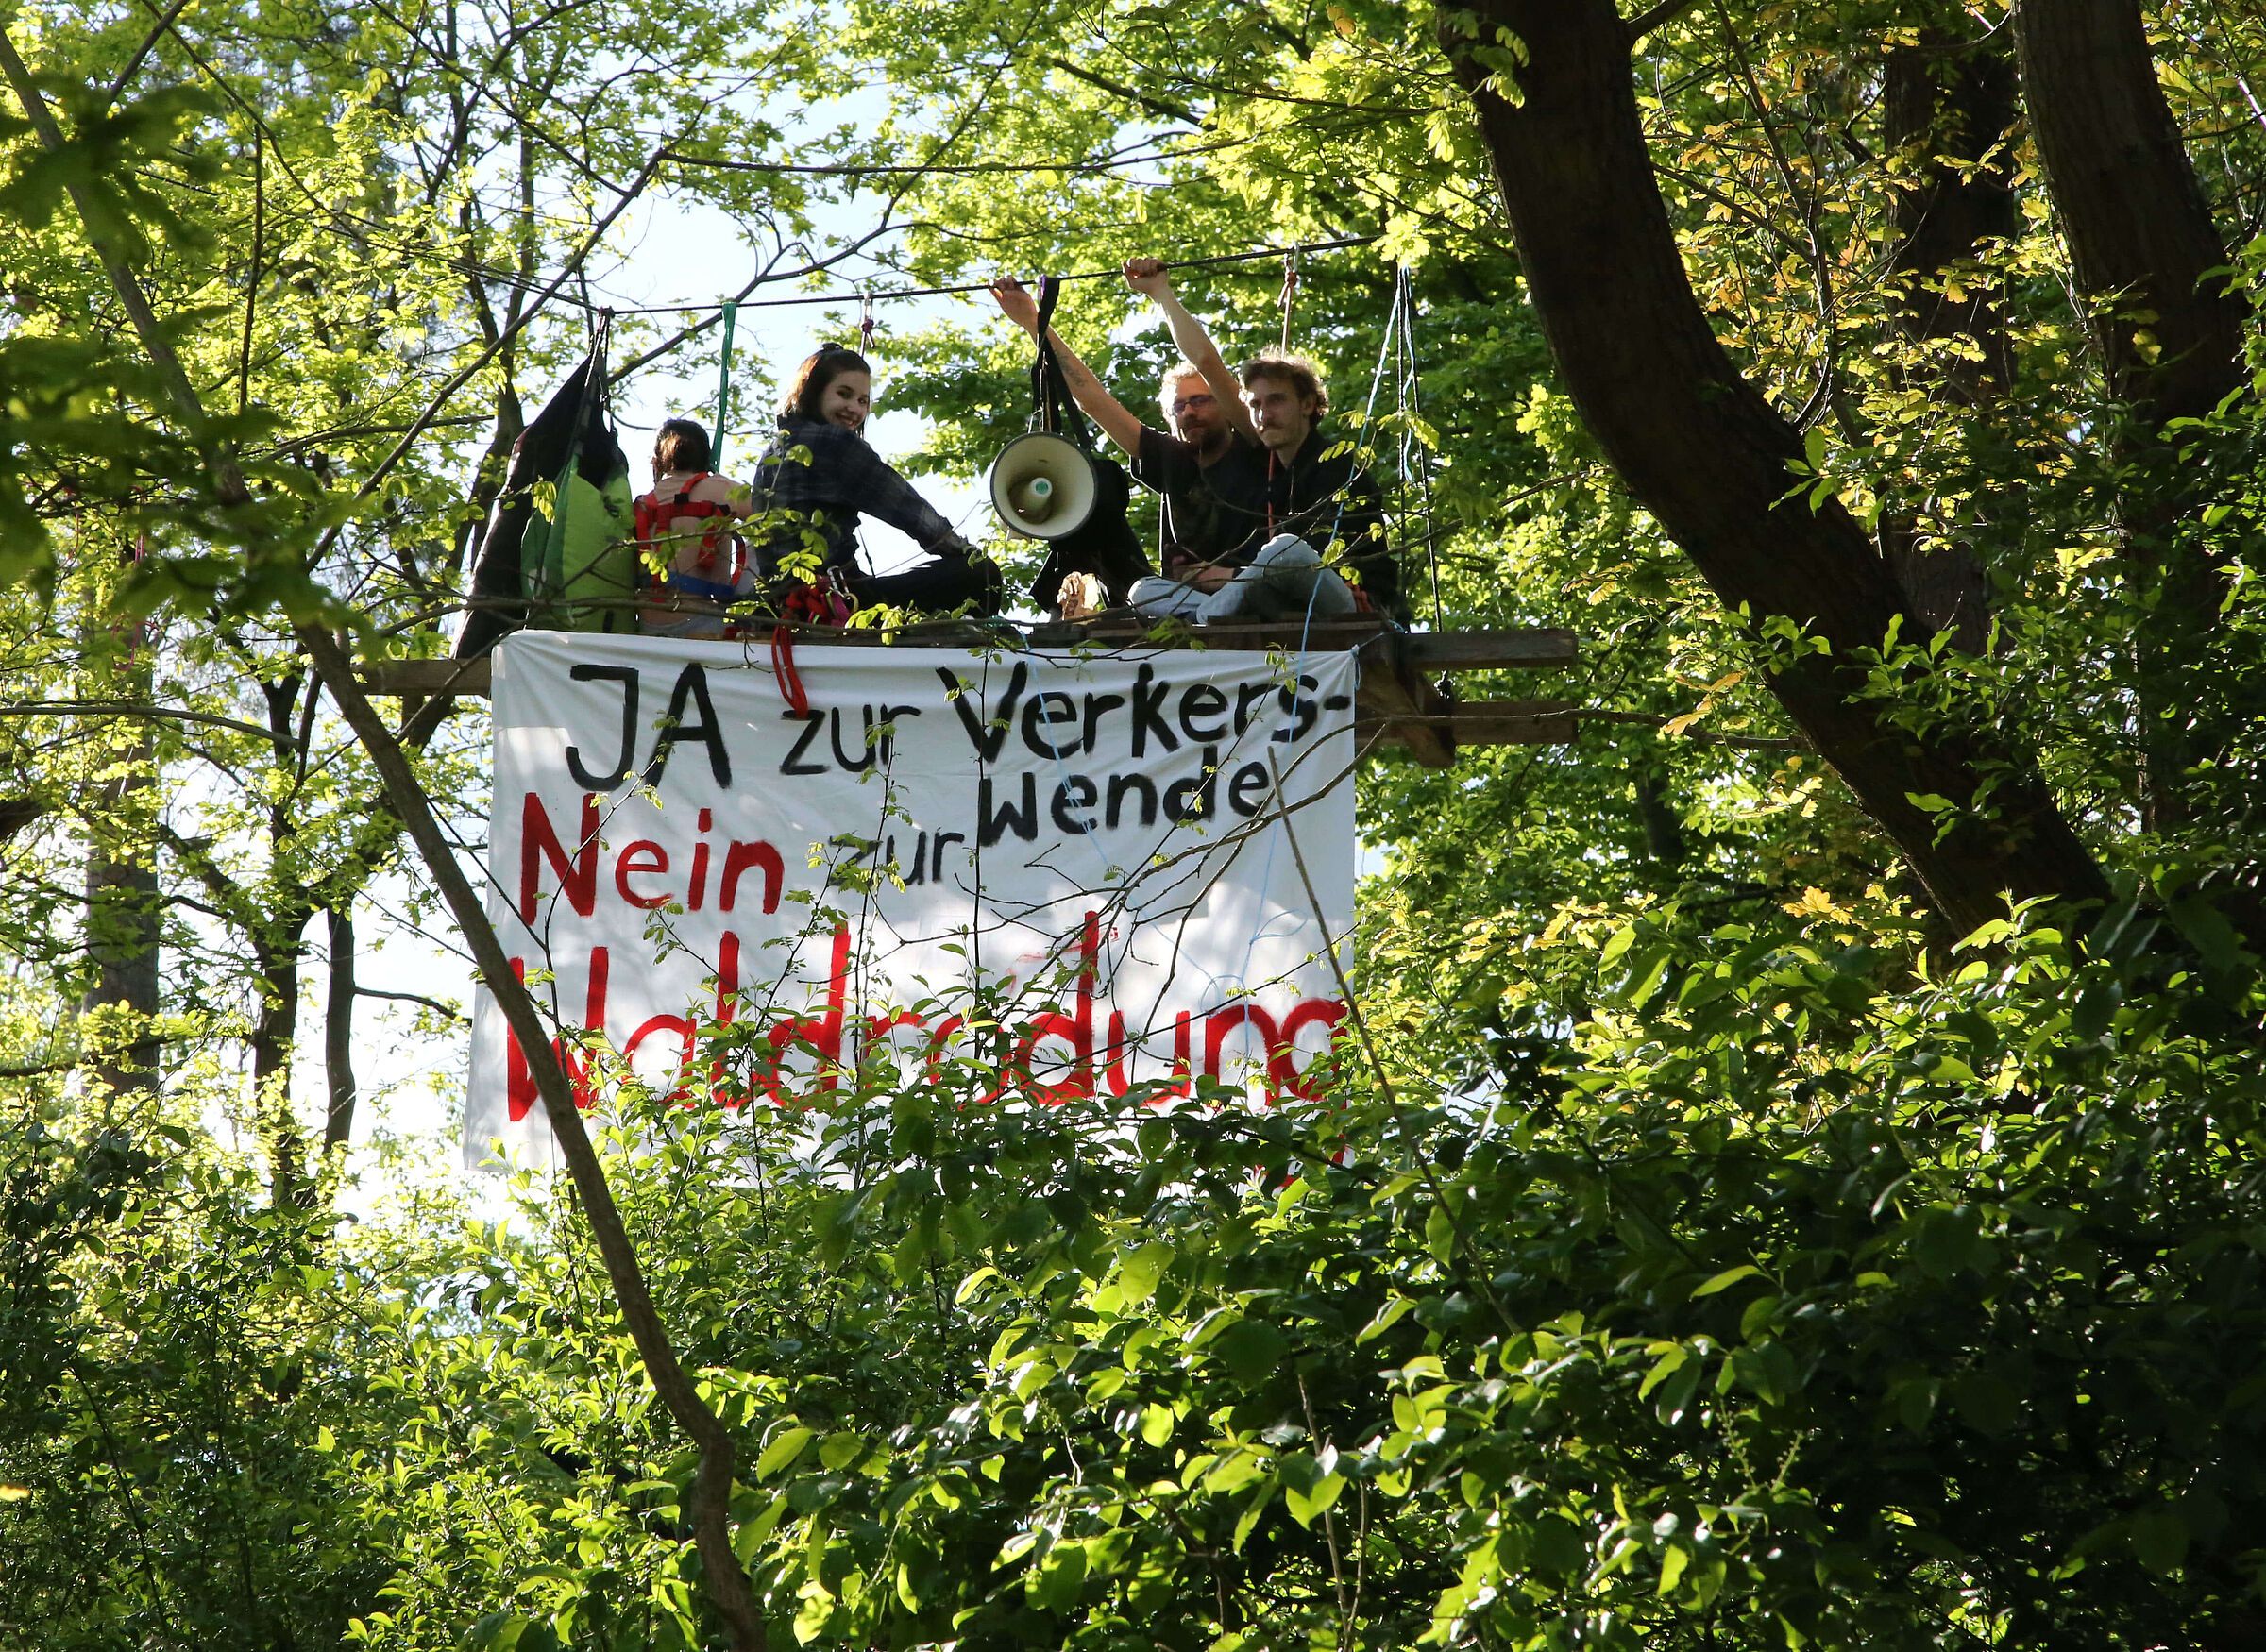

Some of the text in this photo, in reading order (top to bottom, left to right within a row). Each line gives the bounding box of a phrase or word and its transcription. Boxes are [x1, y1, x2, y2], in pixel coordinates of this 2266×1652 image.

[566, 662, 733, 792] JA
[780, 702, 922, 776] zur
[520, 791, 966, 927] Nein zur
